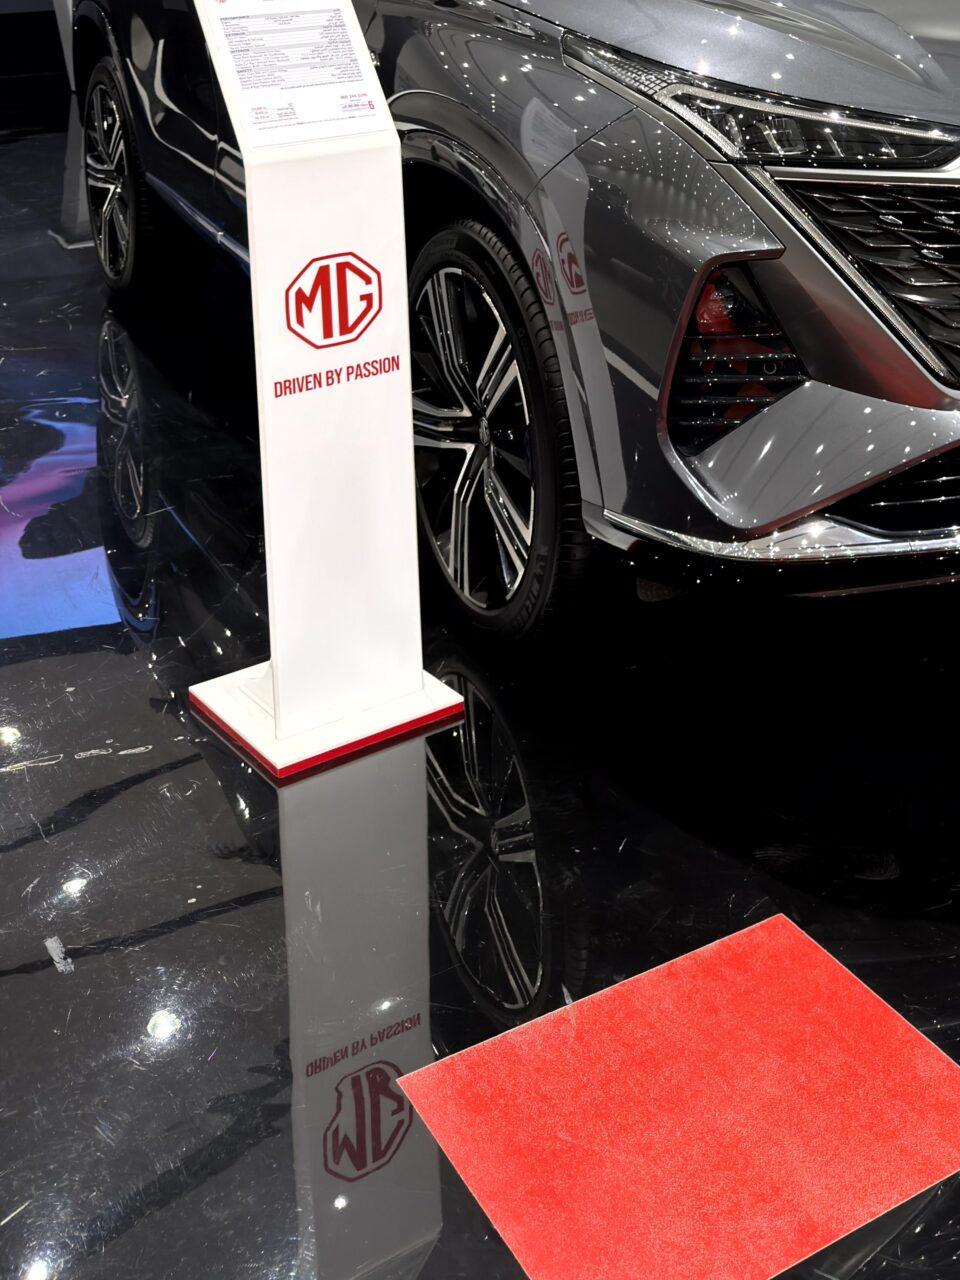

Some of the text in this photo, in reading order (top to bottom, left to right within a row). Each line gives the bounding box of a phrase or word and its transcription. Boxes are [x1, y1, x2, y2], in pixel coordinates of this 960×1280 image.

[291, 257, 377, 344] MG
[274, 355, 400, 398] DRIVEN BY PASSION
